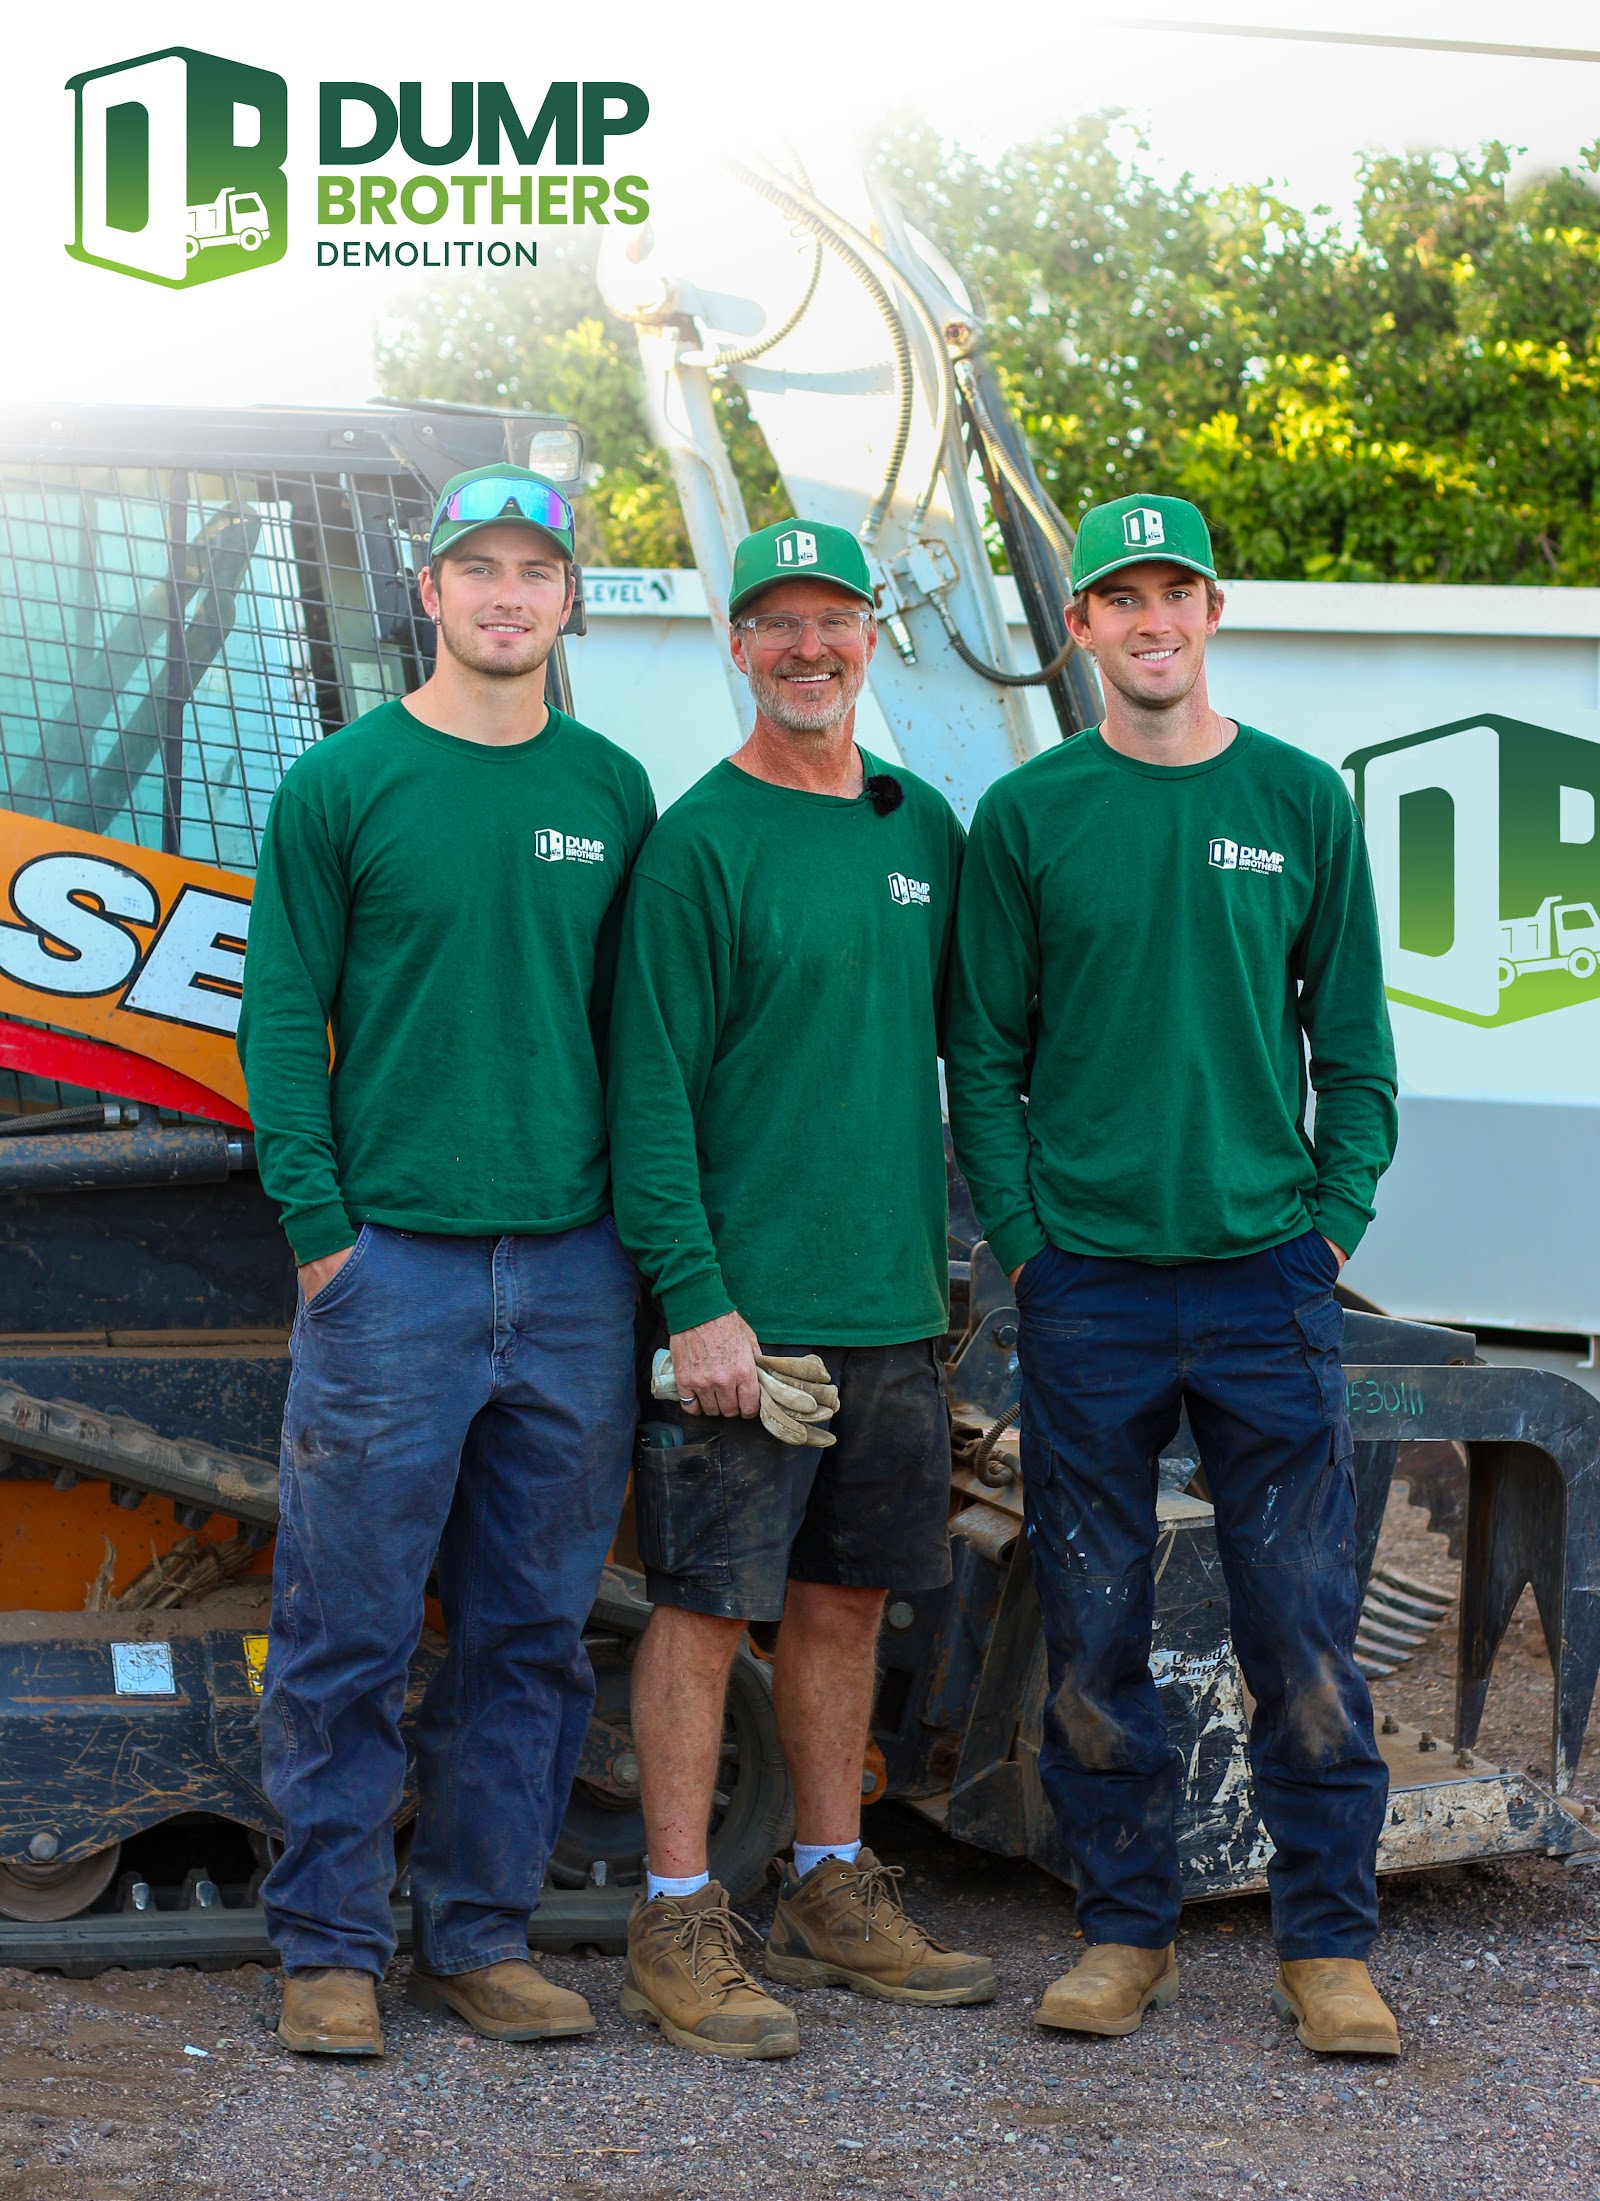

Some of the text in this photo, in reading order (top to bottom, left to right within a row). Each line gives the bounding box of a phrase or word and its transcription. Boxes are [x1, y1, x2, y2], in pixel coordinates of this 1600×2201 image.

[584, 583, 644, 602] LEVEL
[565, 835, 605, 854] DUMP
[565, 847, 605, 862] BROTHERS
[1240, 846, 1285, 865] DUMP
[1238, 858, 1283, 873] BROTHERS
[907, 878, 931, 895] DMP
